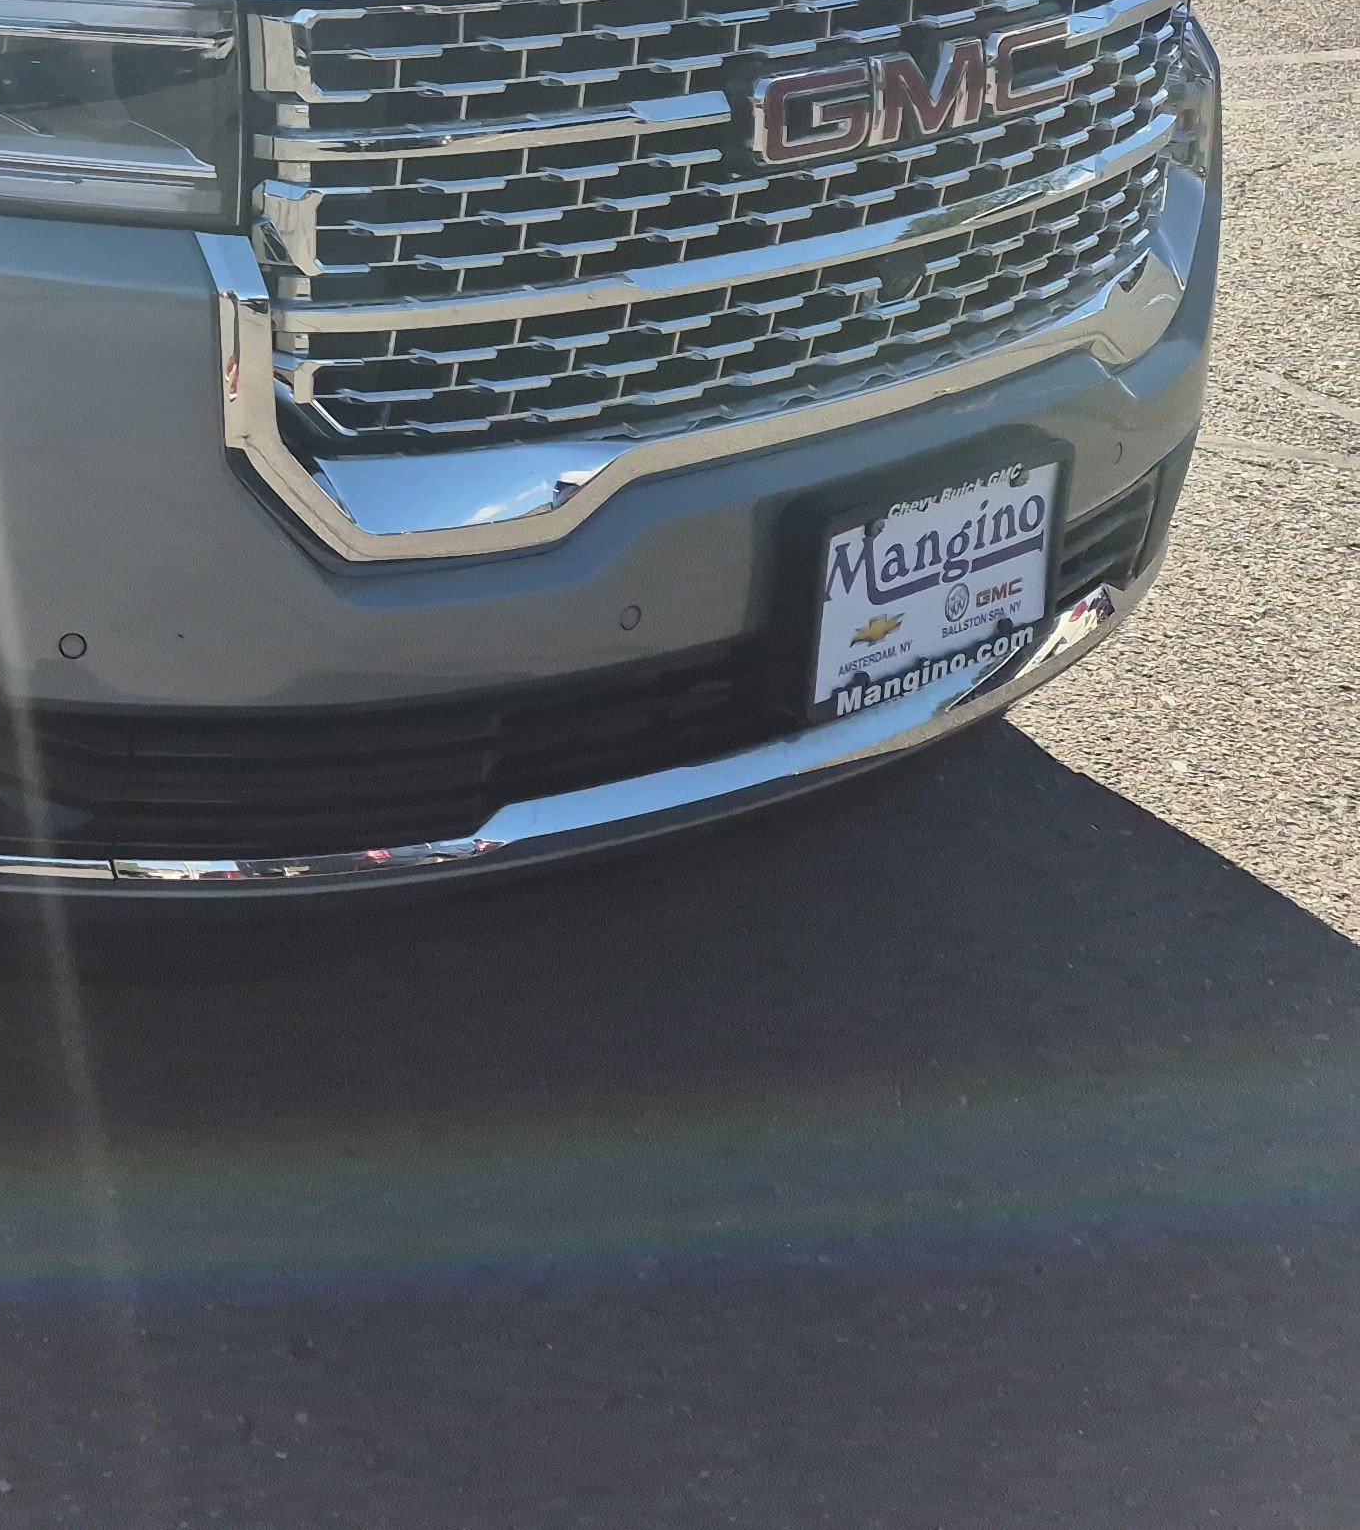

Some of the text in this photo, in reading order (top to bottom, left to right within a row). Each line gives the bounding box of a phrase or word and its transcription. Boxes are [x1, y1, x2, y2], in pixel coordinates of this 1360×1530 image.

[752, 15, 1071, 166] GMC
[987, 462, 1023, 486] GMC
[823, 494, 1045, 605] Mangino
[976, 577, 1023, 608] GMC
[836, 626, 1034, 717] Mangino.com
[899, 640, 913, 657] NY
